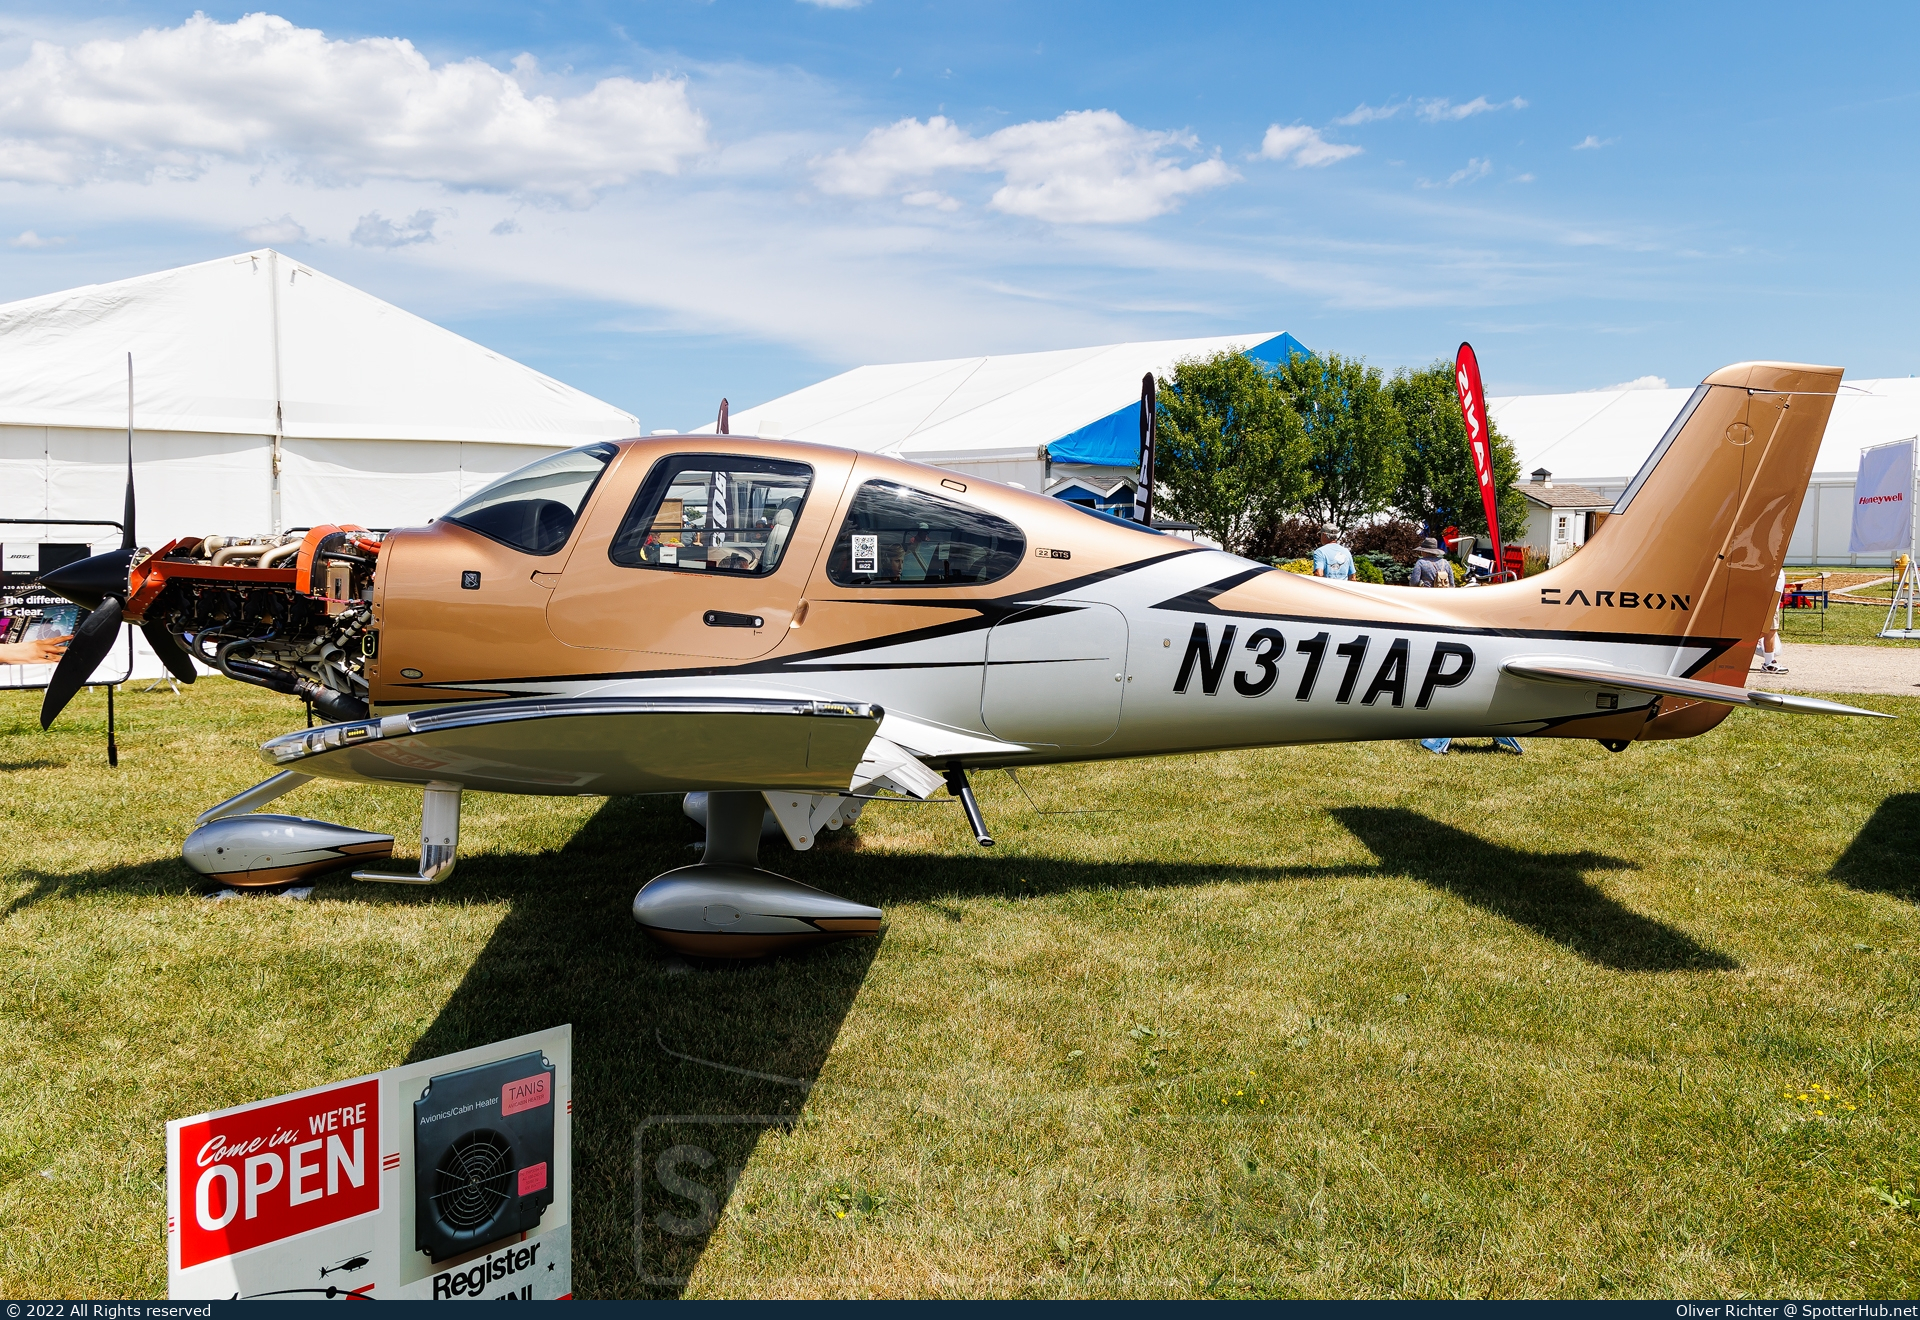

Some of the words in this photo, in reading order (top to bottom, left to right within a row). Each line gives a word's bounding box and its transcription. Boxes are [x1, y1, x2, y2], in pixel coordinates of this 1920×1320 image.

[1858, 492, 1903, 505] Honeywell
[1052, 550, 1069, 558] GTS
[3, 595, 24, 605] The
[25, 595, 74, 605] differenc
[1541, 588, 1690, 611] CARBON
[3, 607, 13, 617] is
[14, 607, 44, 617] clear.
[1172, 621, 1476, 710] N311AP
[509, 1080, 544, 1100] TANIS
[528, 1094, 544, 1104] HEATER
[419, 1104, 474, 1126] Avionics/Cabin
[475, 1096, 500, 1111] Heater
[197, 1134, 268, 1167] Come
[308, 1103, 367, 1136] WE'RE
[195, 1127, 365, 1232] OPEN
[433, 1242, 541, 1300] Register
